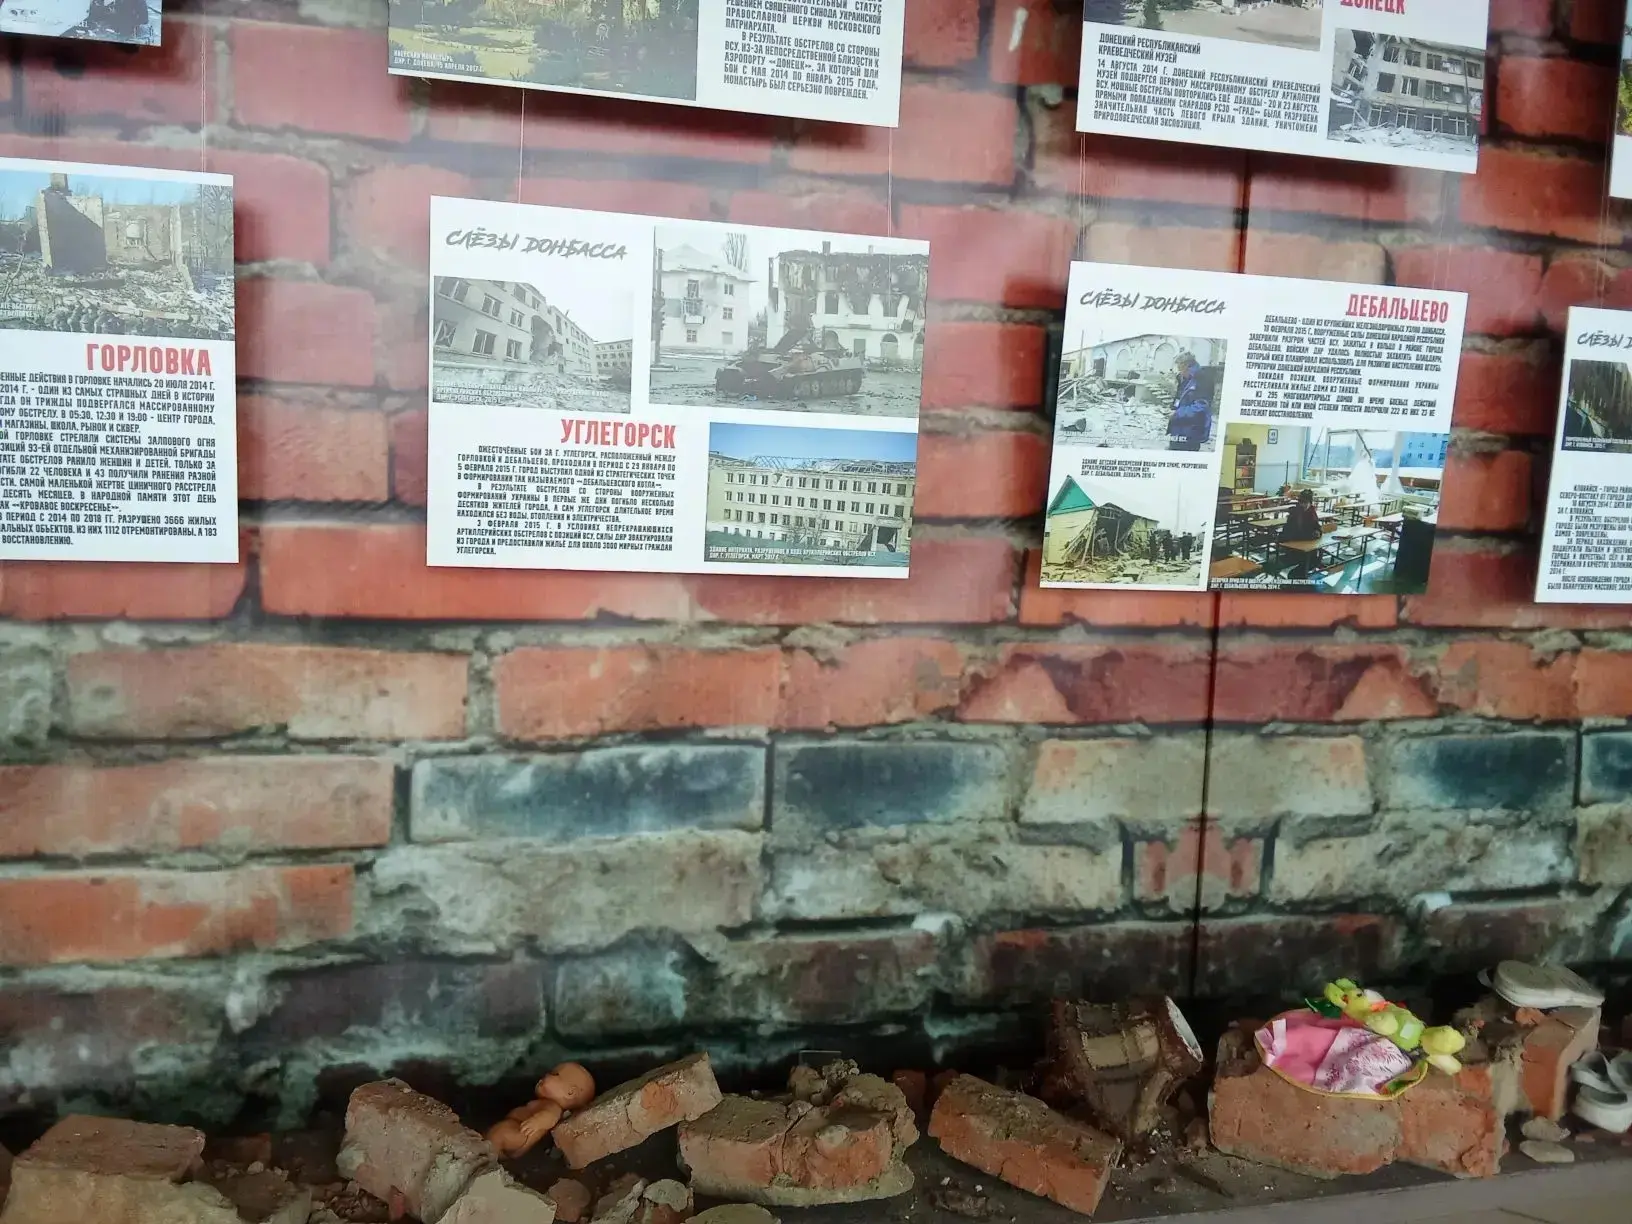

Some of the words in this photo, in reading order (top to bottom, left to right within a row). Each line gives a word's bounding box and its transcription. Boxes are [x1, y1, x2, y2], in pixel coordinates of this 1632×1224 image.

[764, 0, 808, 15] СВЯЩЕННОГО
[810, 6, 837, 18] СИНОДА
[839, 9, 881, 24] УКРАИНСКОЙ
[855, 2, 882, 12] СТАТУС
[1341, 0, 1405, 14] ЕЦК
[792, 14, 822, 28] ЦЕРКВИ
[748, 32, 792, 46] РЕЗУЛЬТАТЕ
[793, 37, 834, 51] ОБСТРЕЛОВ
[847, 44, 880, 57] СТОРОНЫ
[1099, 32, 1136, 46] ДОНЕЦКИЙ
[741, 42, 763, 54] ИЗ-ЗА
[837, 53, 873, 67] БЛИЗОСТИ
[1154, 51, 1177, 63] МУЗЕЙ
[724, 51, 765, 65] АЭРОПОРТУ
[828, 63, 861, 76] КОТОРЫЙ
[863, 68, 878, 78] ШЛИ
[723, 62, 738, 73] БОИ
[751, 65, 766, 76] МАЯ
[770, 68, 788, 79] 2014
[805, 72, 832, 84] ЯНВАРЬ
[836, 75, 854, 87] 2015
[723, 73, 767, 88] МОНАСТЫРЬ
[768, 78, 785, 90] БЫЛ
[787, 81, 822, 94] СЕРЬЕЗНО
[446, 227, 519, 250] СЛЁЗЫ
[521, 237, 628, 260] ДОНБАССА
[1080, 288, 1140, 308] СЛЁЗЫ
[1140, 296, 1226, 314] ДОНБАССА
[1346, 294, 1448, 323] ДЕБАЛЬЦЕВО
[1577, 331, 1624, 348] СЛЁЗЫ
[87, 344, 212, 376] ГОРЛОВКА
[28, 372, 66, 383] ДЕЙСТВИЯ
[68, 374, 73, 383] В
[74, 374, 111, 385] ГОРЛОВКЕ
[113, 376, 152, 387] НАЧАЛИСЬ
[154, 378, 163, 388] 20
[165, 379, 187, 388] ИЮЛЯ
[189, 380, 207, 390] 2014
[0, 383, 19, 393] 2014
[37, 385, 59, 395] ОДИН
[62, 386, 72, 395] ИЗ
[74, 386, 102, 396] САМЫХ
[106, 388, 147, 398] СТРАШНЫХ
[150, 390, 171, 400] ДНЕЙ
[174, 391, 179, 400] В
[181, 391, 214, 401] ИСТОРИИ
[20, 396, 31, 405] ОН
[34, 396, 72, 407] ТРИЖДЫ
[76, 398, 135, 409] ПОДВЕРГАЛСЯ
[139, 401, 214, 413] МАССИРОВАННОМУ
[60, 409, 66, 418] В
[96, 410, 116, 420] 12:30
[118, 412, 124, 420] И
[127, 412, 147, 421] 19:00
[156, 413, 180, 423] ЦЕНТР
[80, 422, 106, 431] РЫНОК
[108, 423, 114, 431] И
[561, 419, 676, 449] УГЛЕГОРСК
[15, 431, 53, 441] ГОРЛОВКЕ
[60, 432, 99, 442] СТРЕЛЯЛИ
[105, 434, 141, 444] СИСТЕМЫ
[147, 435, 190, 446] ЗАЛПОВОГО
[196, 437, 215, 447] ОГНЯ
[0, 442, 25, 452] ЗИЦИЙ
[27, 442, 50, 452] 93-ЕЙ
[53, 444, 97, 454] ОТДЕЛЬНОЙ
[99, 445, 177, 456] МЕХАНИЗИРОВАННОЙ
[180, 448, 215, 458] БРИГАДЫ
[19, 454, 63, 464] ОБСТРЕЛОВ
[66, 456, 96, 465] РАНИЛО
[99, 457, 132, 466] ЖЕНЩИН
[135, 458, 140, 467] И
[174, 459, 202, 469] ТОЛЬКО
[206, 460, 216, 469] ЗА
[29, 466, 40, 476] 22
[42, 466, 82, 476] ЧЕЛОВЕКА
[85, 468, 90, 476] И
[94, 468, 104, 477] 43
[108, 468, 148, 478] ПОЛУЧИЛИ
[151, 470, 184, 479] РАНЕНИЯ
[187, 471, 216, 480] РАЗНОЙ
[19, 477, 45, 487] САМОЙ
[47, 478, 92, 488] МАЛЕНЬКОЙ
[95, 479, 125, 489] ЖЕРТВЕ
[128, 480, 171, 490] ЦИНИЧНОГО
[174, 482, 216, 492] РАССТРЕЛА
[2, 488, 32, 498] ДЕСЯТЬ
[79, 490, 85, 499] В
[90, 491, 131, 500] НАРОДНОЙ
[137, 492, 166, 501] ПАМЯТИ
[172, 493, 190, 502] ЭТОТ
[196, 493, 216, 503] ДЕНЬ
[5, 511, 36, 521] ПЕРИОД
[39, 512, 44, 521] С
[47, 512, 67, 522] 2014
[70, 513, 80, 522] ПО
[83, 513, 102, 522] 2018
[117, 514, 160, 524] РАЗРУШЕНО
[164, 515, 184, 524] 3666
[187, 516, 216, 525] ЖИЛЫХ
[76, 524, 86, 533] ИЗ
[87, 525, 102, 534] НИХ
[104, 525, 120, 534] 1112
[197, 527, 202, 536] А
[204, 527, 217, 536] 183
